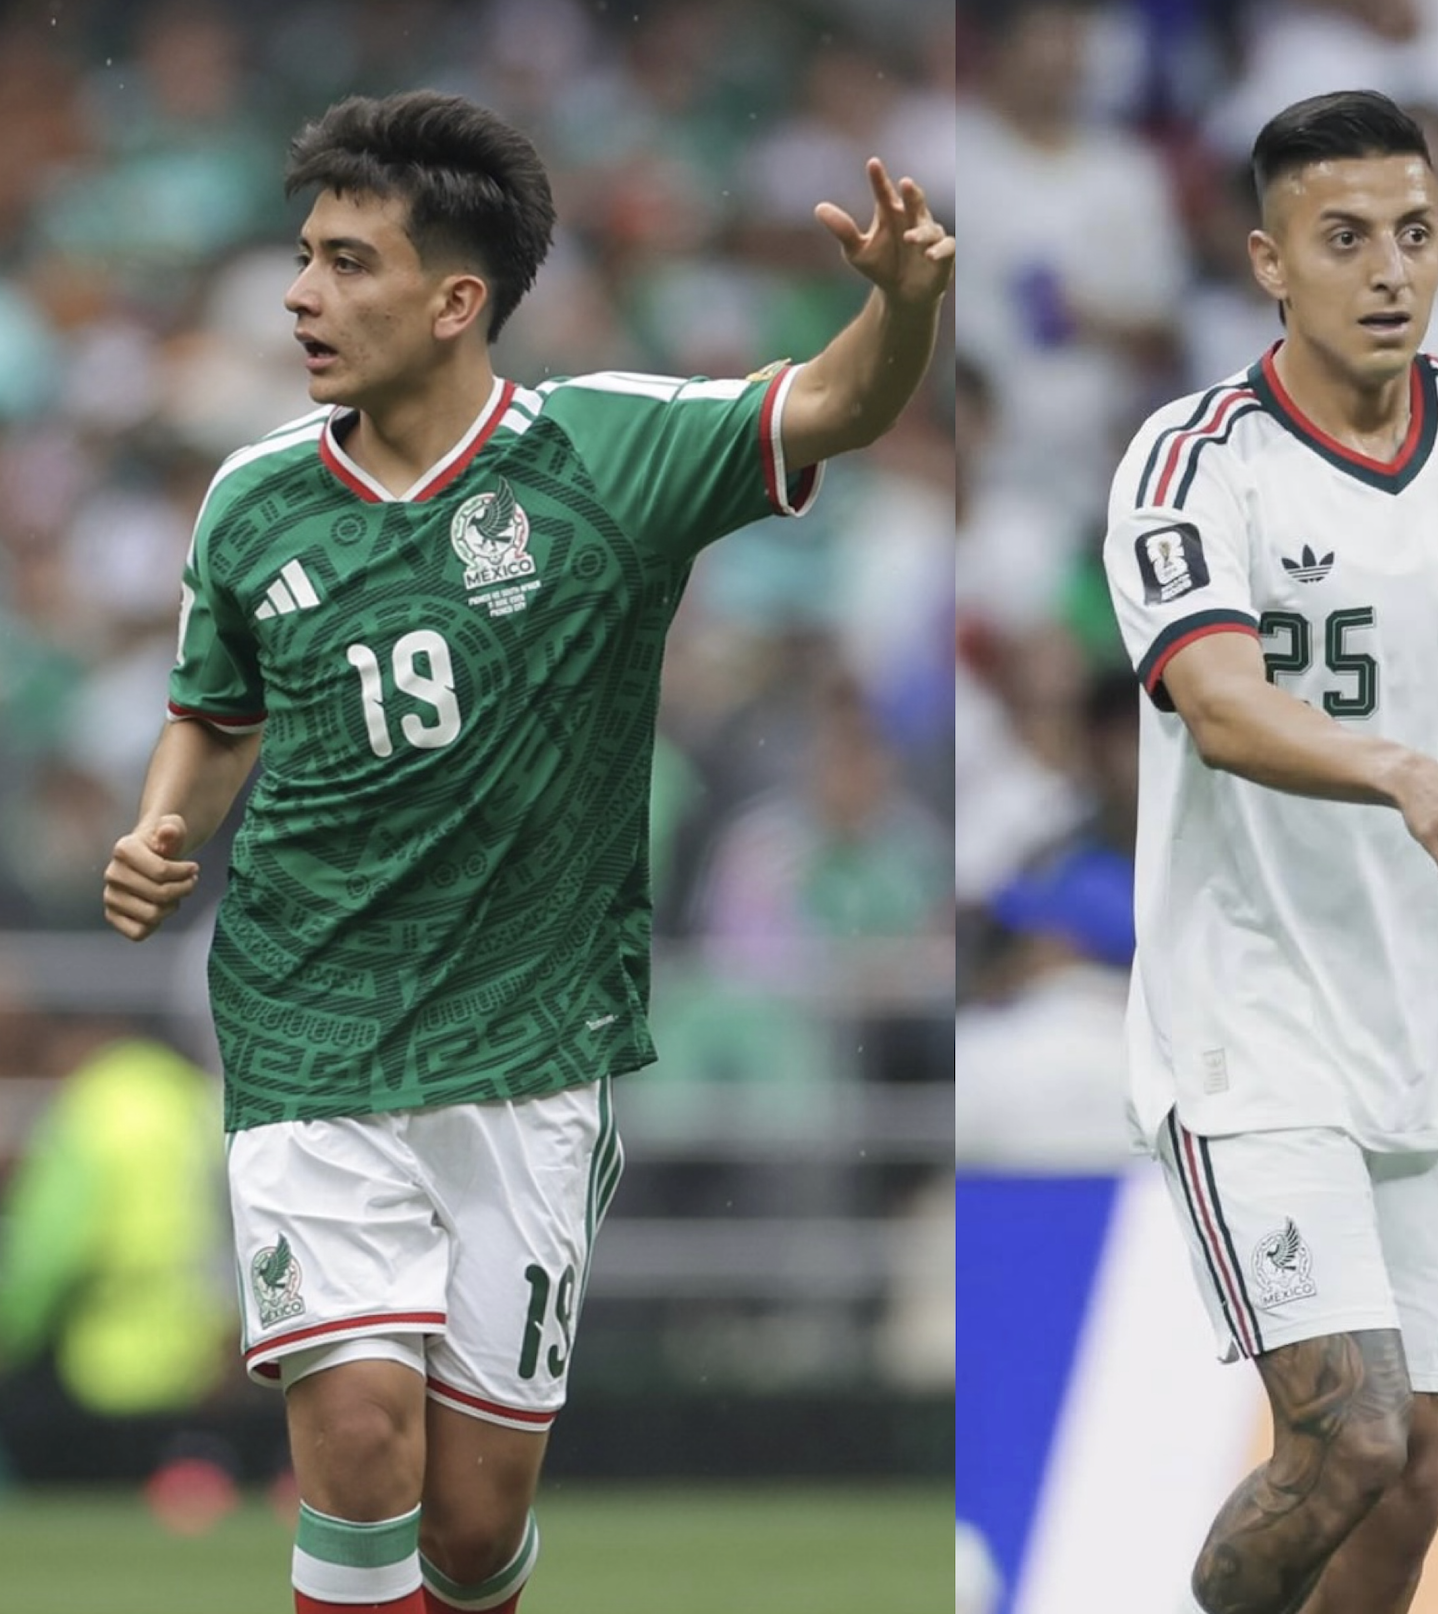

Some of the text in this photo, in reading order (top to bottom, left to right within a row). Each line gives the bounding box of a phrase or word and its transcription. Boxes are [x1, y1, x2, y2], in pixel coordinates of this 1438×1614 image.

[346, 628, 461, 757] 19
[1258, 606, 1379, 720] 25
[518, 1264, 576, 1379] 19
